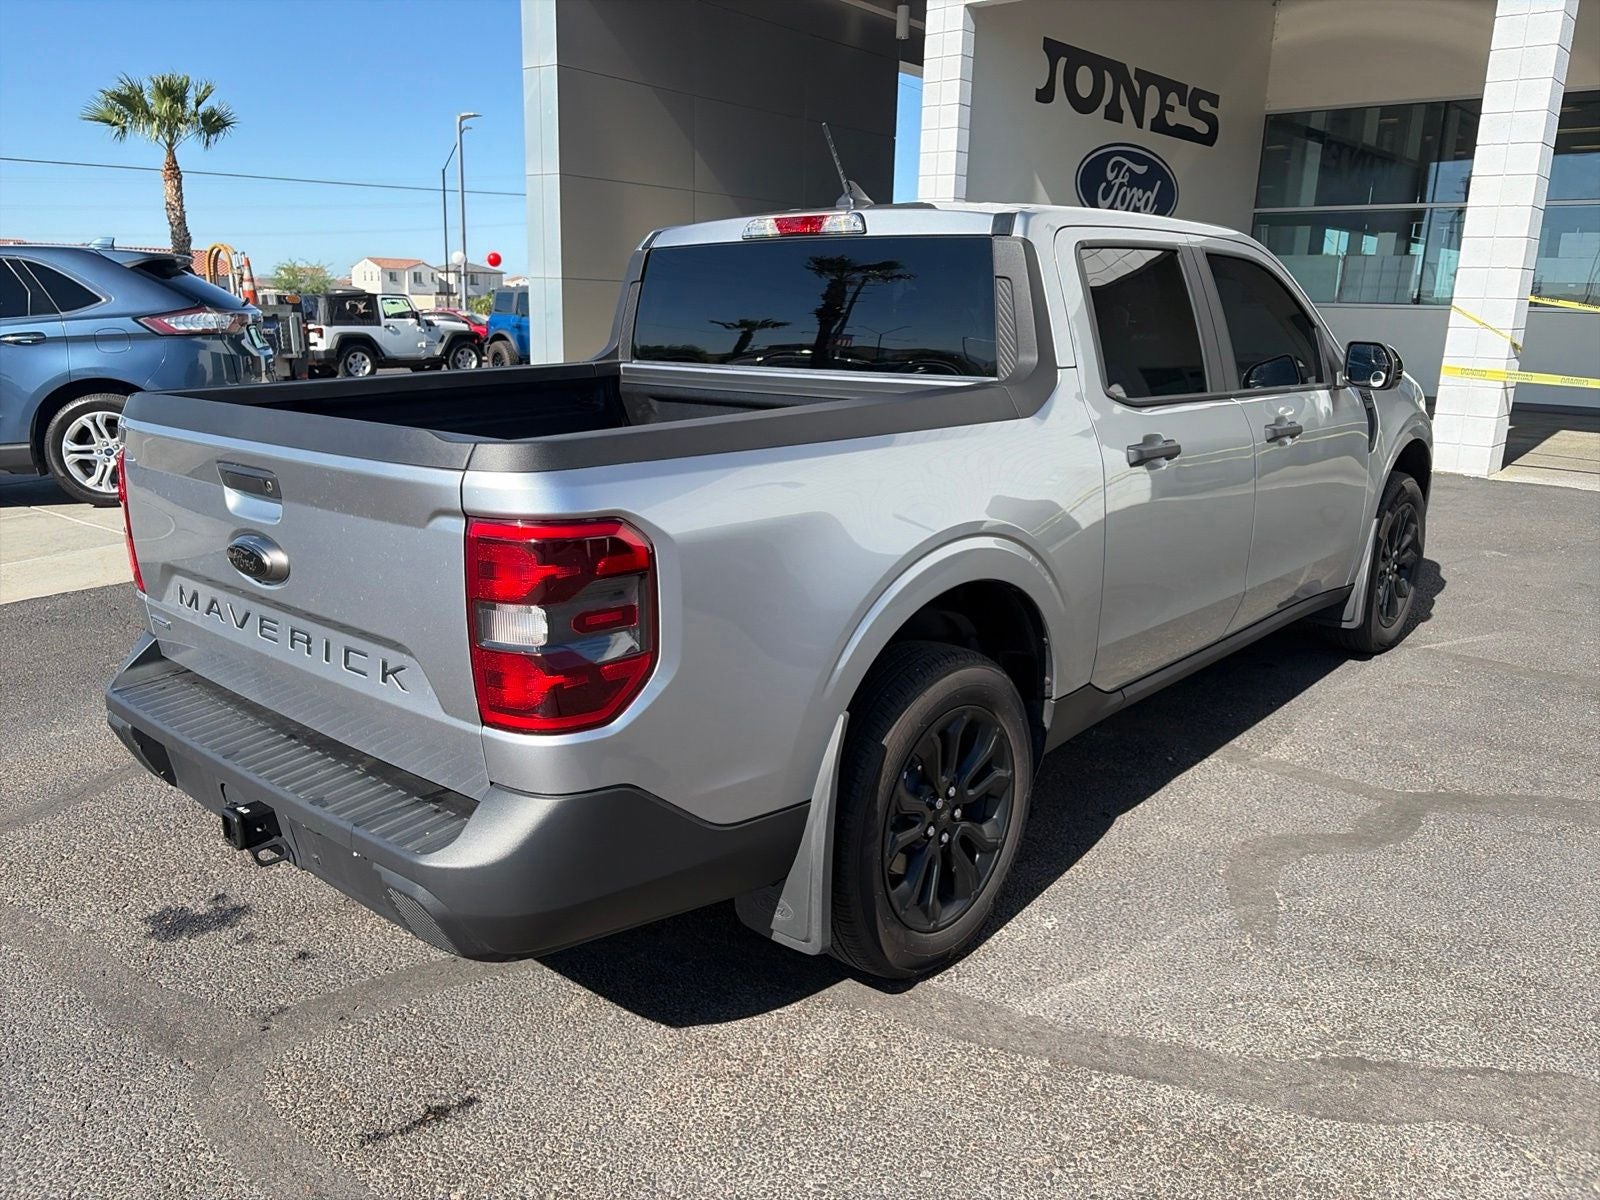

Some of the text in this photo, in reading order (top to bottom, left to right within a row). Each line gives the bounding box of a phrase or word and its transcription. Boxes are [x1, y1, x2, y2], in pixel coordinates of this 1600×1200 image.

[1035, 36, 1220, 147] JONES
[1097, 156, 1161, 213] Ford
[177, 583, 410, 694] MAVERICK
